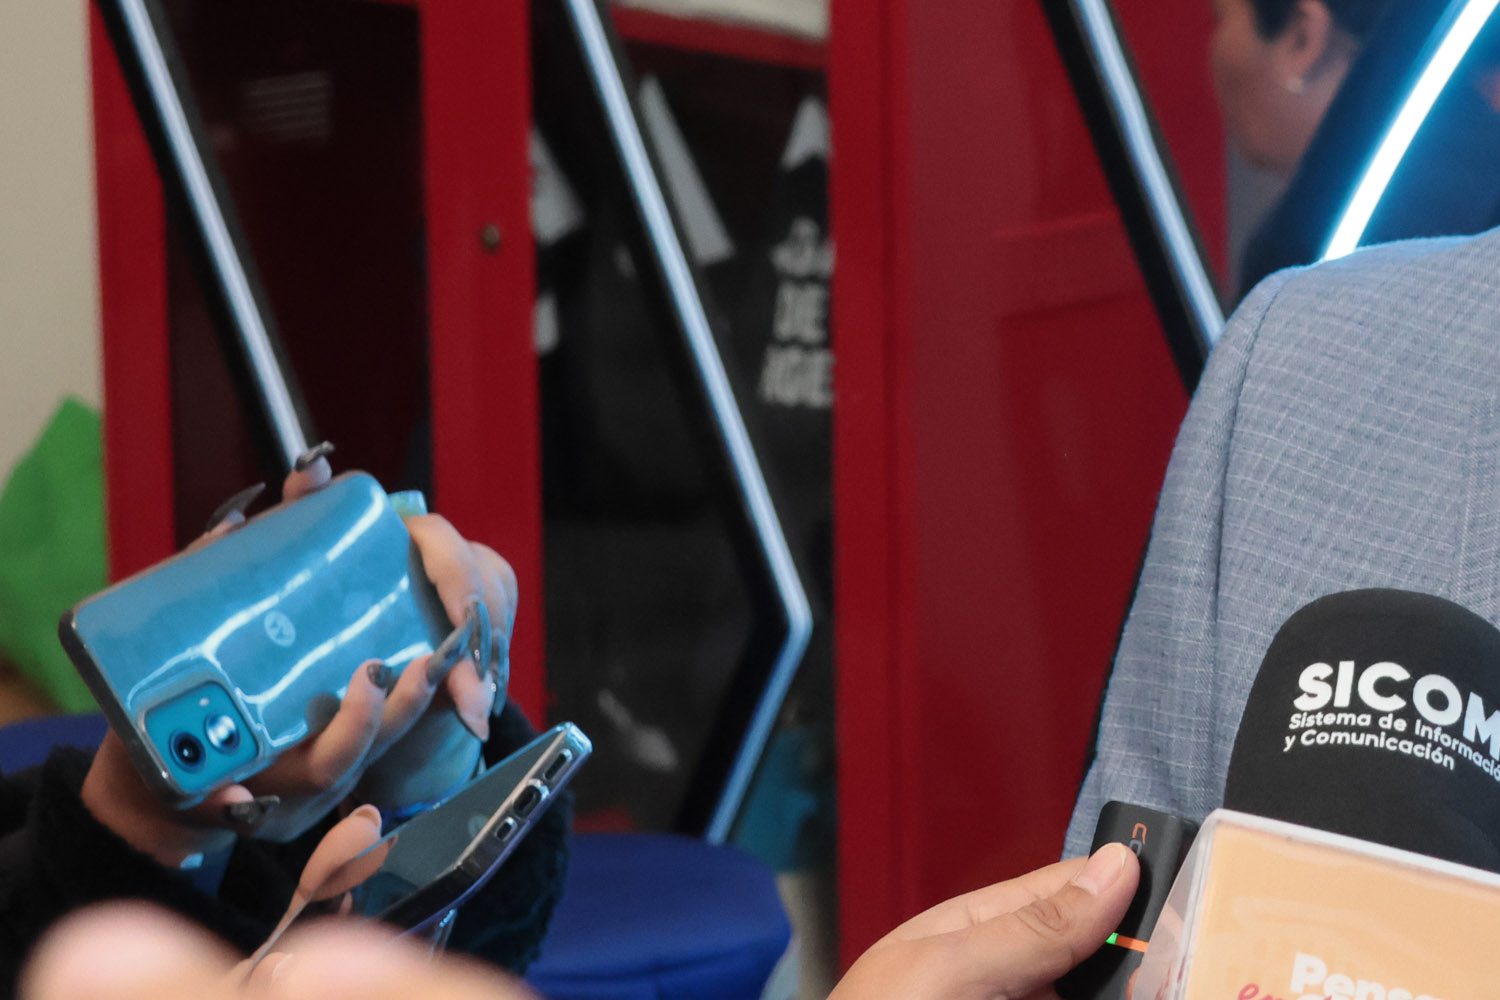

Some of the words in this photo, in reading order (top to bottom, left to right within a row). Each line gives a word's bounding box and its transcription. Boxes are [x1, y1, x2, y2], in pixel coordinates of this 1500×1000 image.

[1288, 712, 1372, 730] Sistema
[1378, 712, 1407, 732] de
[1283, 735, 1296, 753] y
[1300, 730, 1455, 771] Comunicación
